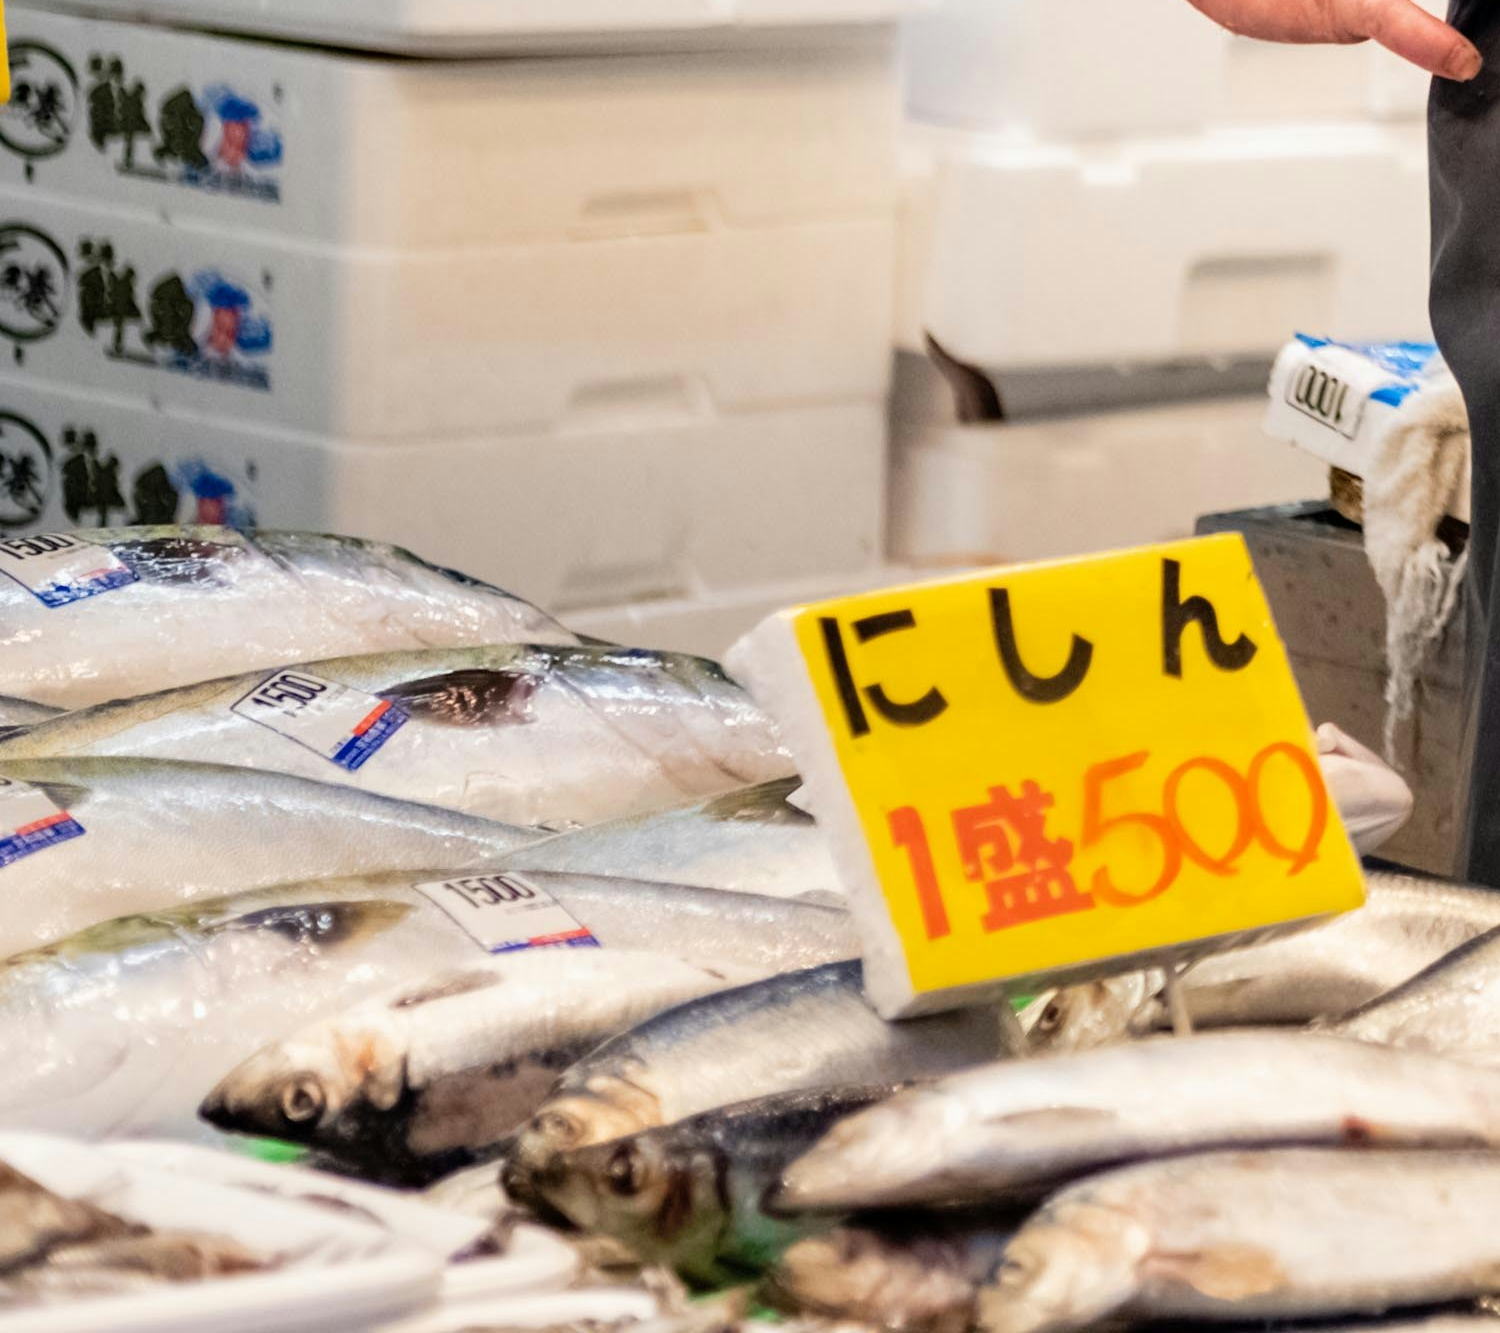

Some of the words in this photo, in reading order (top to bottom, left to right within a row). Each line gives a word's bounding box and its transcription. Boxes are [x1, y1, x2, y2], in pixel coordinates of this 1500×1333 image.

[818, 557, 1259, 739] にしん
[442, 875, 536, 910] 1500
